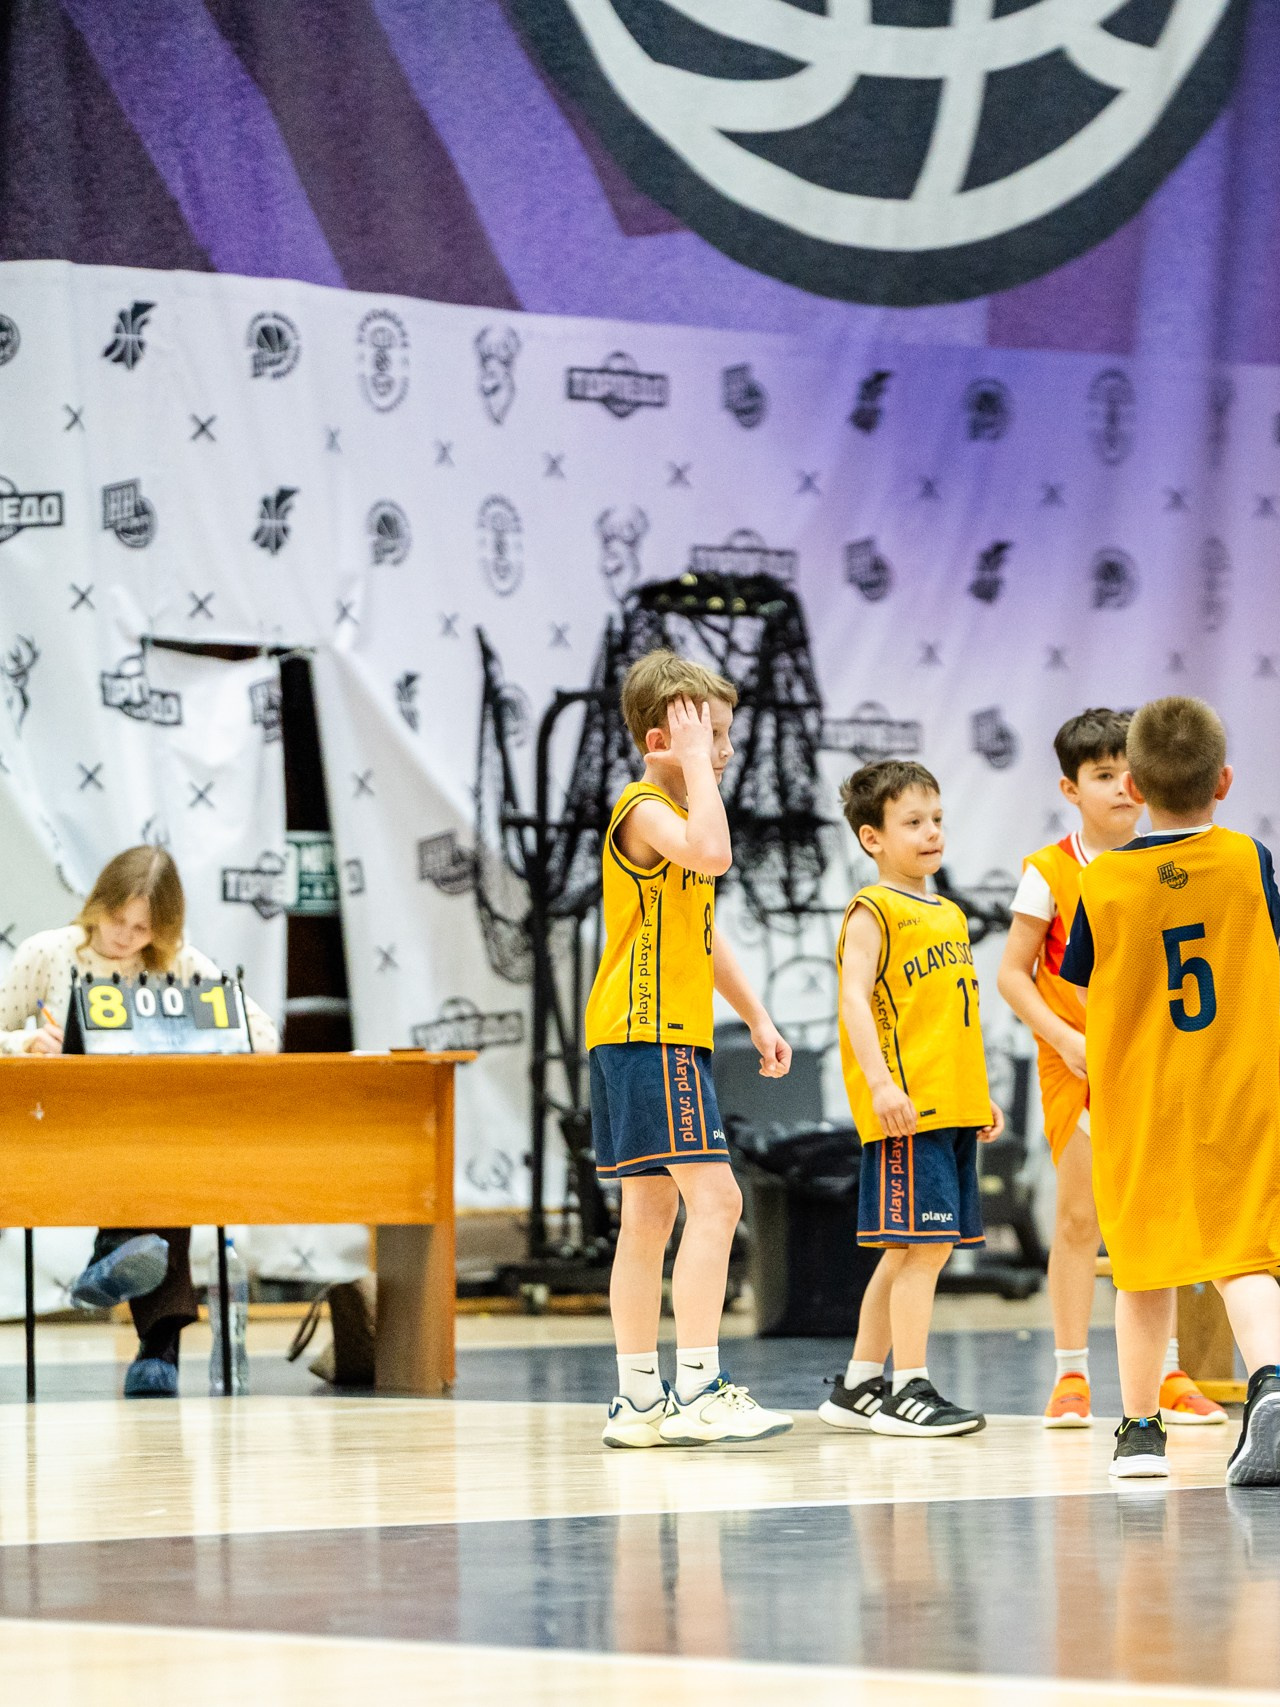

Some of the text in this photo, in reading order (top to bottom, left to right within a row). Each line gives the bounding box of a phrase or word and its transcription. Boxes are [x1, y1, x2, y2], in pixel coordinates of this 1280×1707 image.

[0, 496, 61, 524] ЕДО
[1162, 922, 1217, 1033] 5
[87, 985, 128, 1028] 8
[200, 986, 229, 1028] 1
